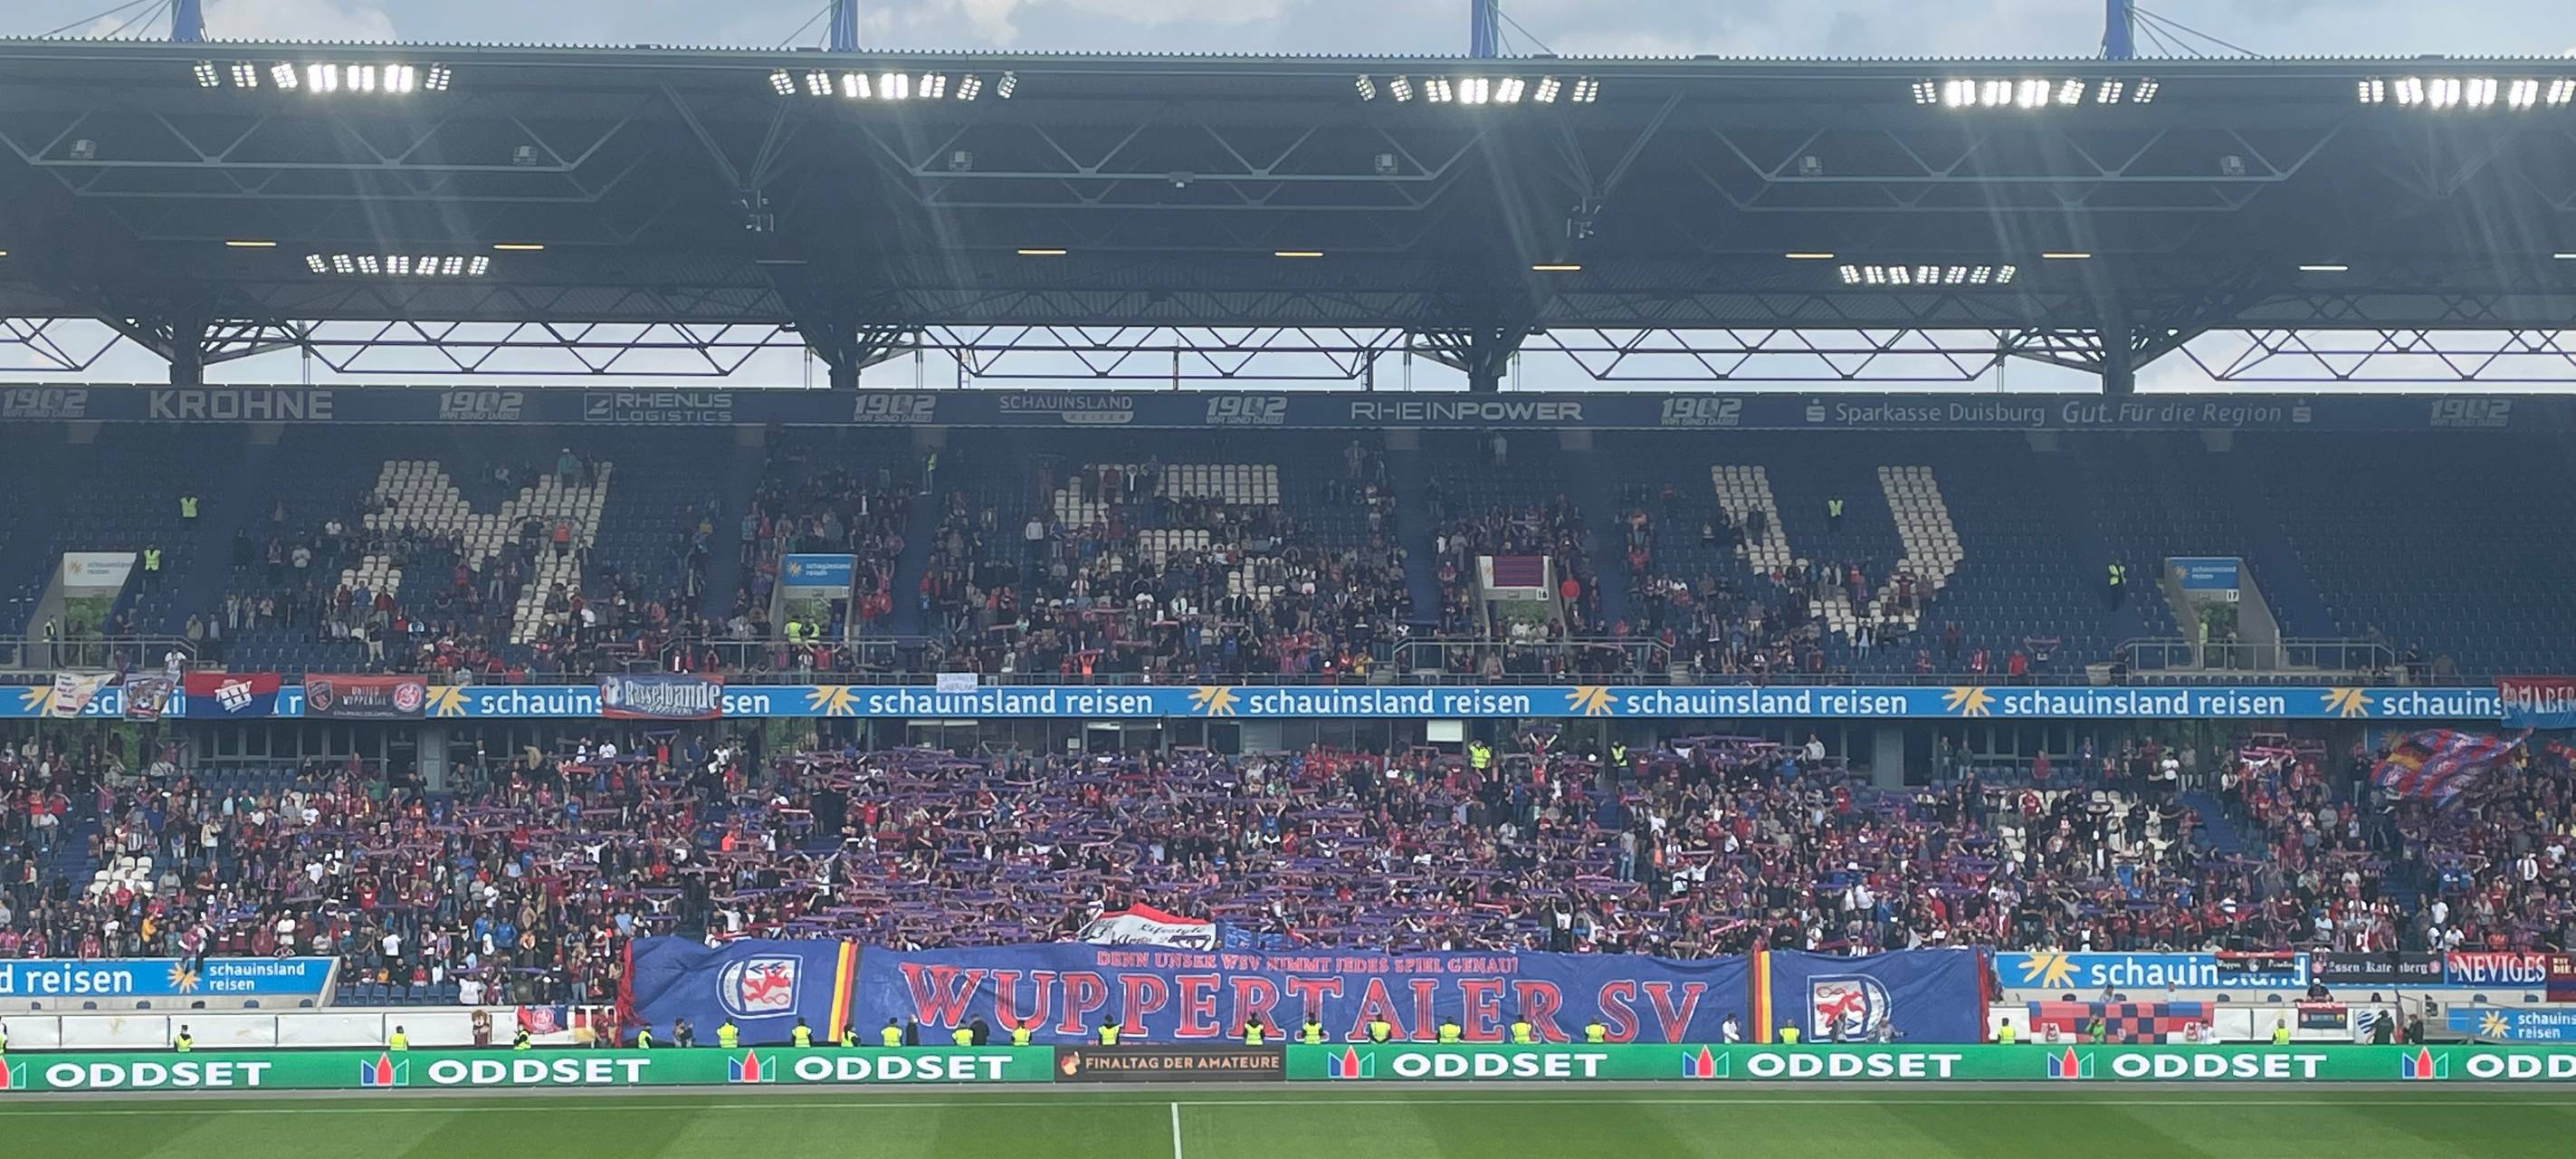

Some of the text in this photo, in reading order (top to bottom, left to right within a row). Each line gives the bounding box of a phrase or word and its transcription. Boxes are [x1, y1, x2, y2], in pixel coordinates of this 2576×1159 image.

[4, 389, 89, 410] 1902
[150, 390, 334, 419] KROHNE
[440, 390, 524, 412] 1902
[616, 392, 733, 407] RHENUS
[854, 394, 936, 414] 1902
[999, 396, 1133, 409] SCHAUINSLAND
[1207, 396, 1288, 416] 1902
[1350, 402, 1584, 420] RHEINPOWER
[1661, 398, 1743, 418] 1902
[616, 410, 733, 422] LOGISTICS
[1835, 401, 2282, 426] Sparkasse Duisburg Gut. Für die Region
[1538, 590, 1548, 599] 16
[2228, 591, 2238, 599] 17
[625, 680, 721, 710] Rasselbande
[868, 689, 1152, 714] schauinsland reisen
[1249, 689, 1530, 714] schauinsland reisen
[1627, 689, 1907, 714] schauinsland reisen
[2003, 689, 2285, 714] schauinsland reisen
[209, 962, 306, 976] schauinsland
[1096, 950, 1520, 973] DENN UNSER WSV NIMMT JEDES SPIEL GENAU!
[2455, 954, 2547, 983] NEVIGES
[26, 963, 134, 994] reisen
[209, 977, 256, 991] reisen
[899, 963, 1707, 1043] WUPPERTALER SV
[2518, 1025, 2562, 1039] reisen
[46, 1061, 272, 1088] ODDSET
[428, 1058, 651, 1085] ODDSET
[794, 1055, 1013, 1081] ODDSET
[1084, 1055, 1281, 1070] FINALTAG DER AMATEURE
[1391, 1052, 1608, 1078] ODDSET
[1746, 1052, 1962, 1078] ODDSET
[2111, 1053, 2327, 1078] ODDSET
